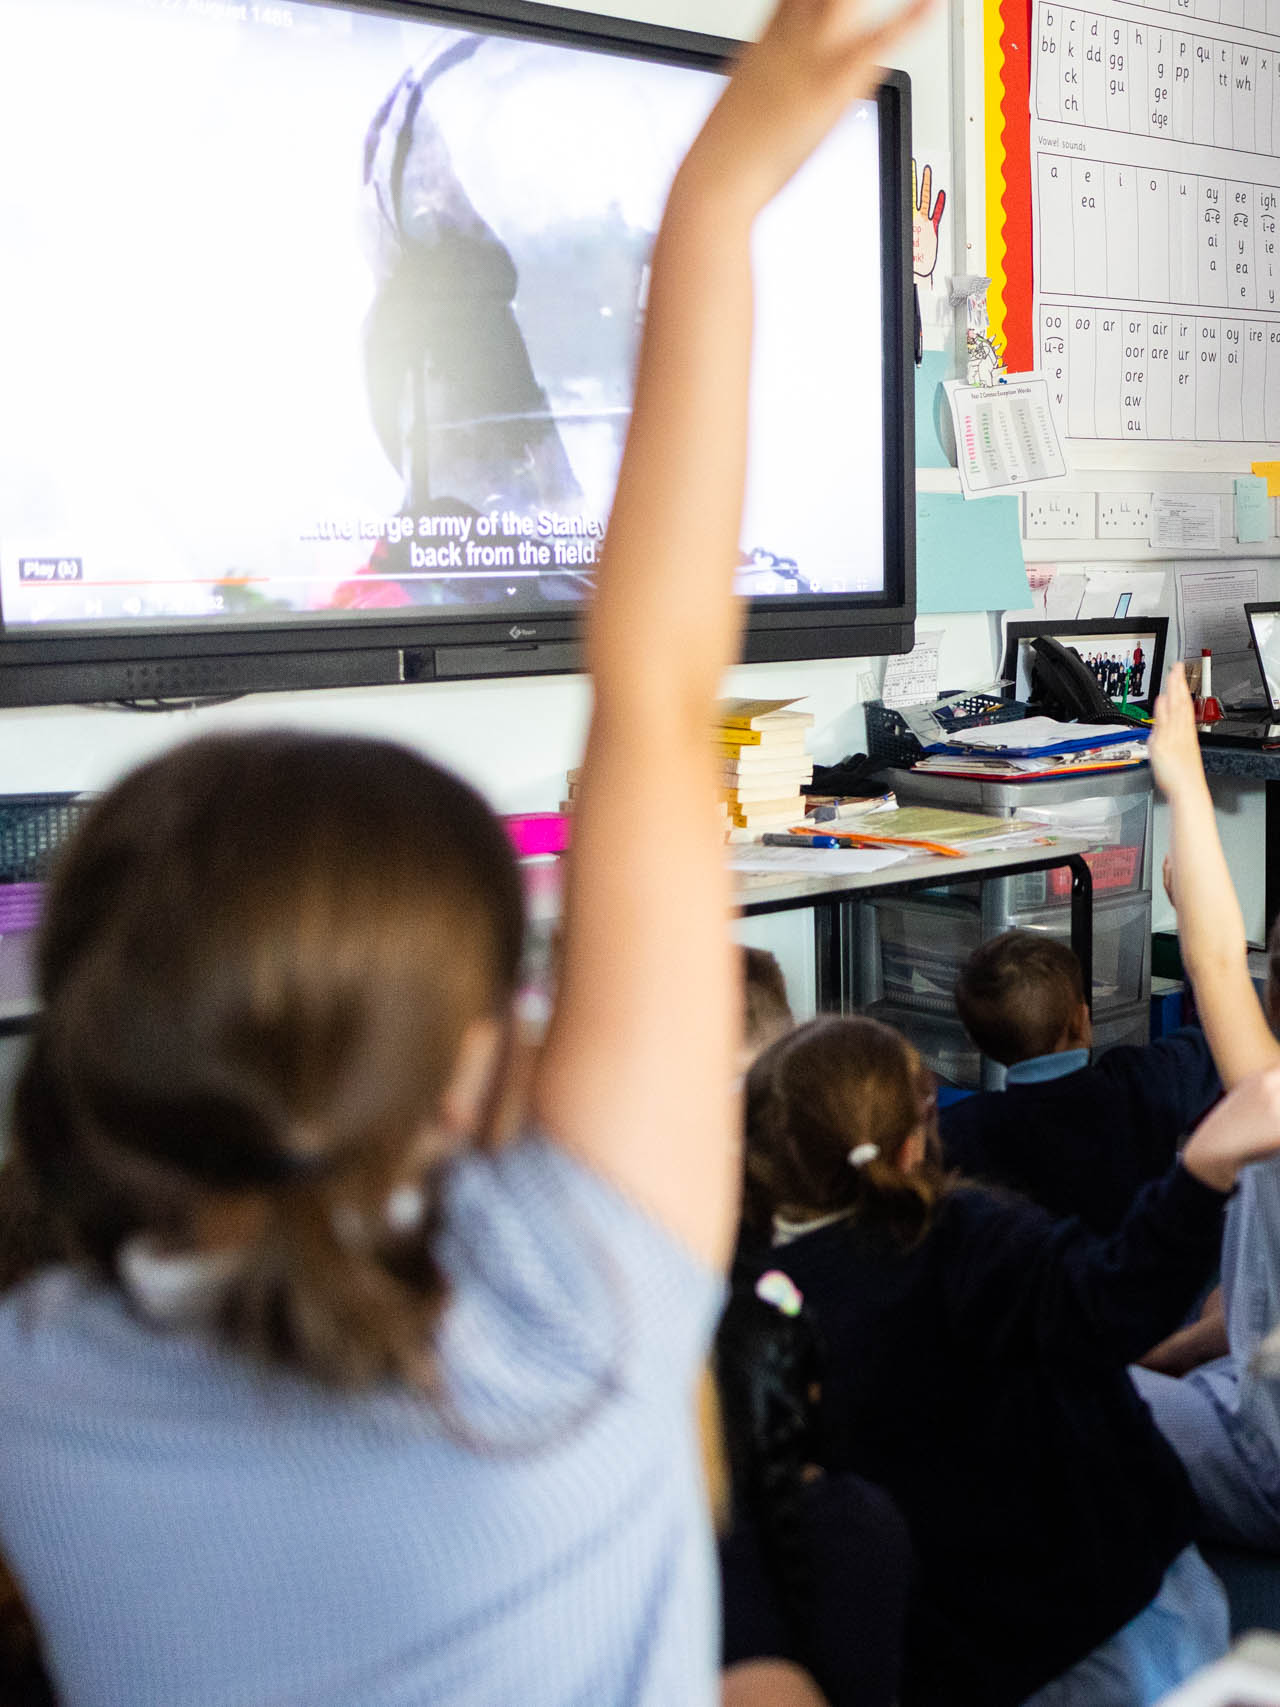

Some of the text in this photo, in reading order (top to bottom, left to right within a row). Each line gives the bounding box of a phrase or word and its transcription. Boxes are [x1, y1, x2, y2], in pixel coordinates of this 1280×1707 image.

[1046, 10, 1053, 26] b
[1091, 20, 1098, 36] d
[1113, 30, 1120, 45] g
[1136, 29, 1142, 45] h
[1042, 36, 1056, 53] bb
[1087, 46, 1101, 62] dd
[1197, 47, 1209, 62] qu
[1110, 53, 1124, 70] gg
[1065, 69, 1077, 84] ck
[1176, 66, 1189, 82] pp
[1219, 73, 1228, 87] tt
[1110, 79, 1124, 94] gu
[1236, 76, 1251, 91] wh
[1155, 87, 1167, 100] ge
[1065, 96, 1078, 111] ch
[1152, 109, 1168, 128] dge
[1038, 136, 1086, 151] Vowel sounds
[1051, 167, 1058, 178] a
[1206, 187, 1218, 203] ay
[1236, 193, 1246, 203] ee
[1260, 193, 1276, 208] igh
[1082, 197, 1096, 208] ea
[1208, 234, 1218, 248] ai
[1265, 241, 1274, 254] ie
[1236, 264, 1248, 274] ea
[1046, 317, 1062, 328] oo
[1076, 319, 1090, 330] oo
[1103, 320, 1115, 332] ar
[1129, 322, 1141, 334] or
[1153, 322, 1167, 336] air
[1180, 324, 1188, 337] ir
[1202, 328, 1215, 339] ou
[1227, 330, 1239, 344] oy
[1250, 328, 1262, 341] ire
[1126, 347, 1144, 358] oor
[1152, 348, 1169, 360] are
[1178, 349, 1189, 361] ur
[1201, 352, 1216, 363] ow
[1228, 351, 1238, 364] oi
[1126, 371, 1144, 382] ore
[1178, 374, 1189, 385] er
[1125, 396, 1141, 406] aw
[1128, 419, 1141, 431] au
[419, 514, 472, 542] army
[476, 511, 499, 536] of
[502, 512, 533, 536] the
[411, 542, 462, 568] back
[466, 541, 515, 567] from
[519, 541, 550, 566] the
[24, 561, 56, 579] Play
